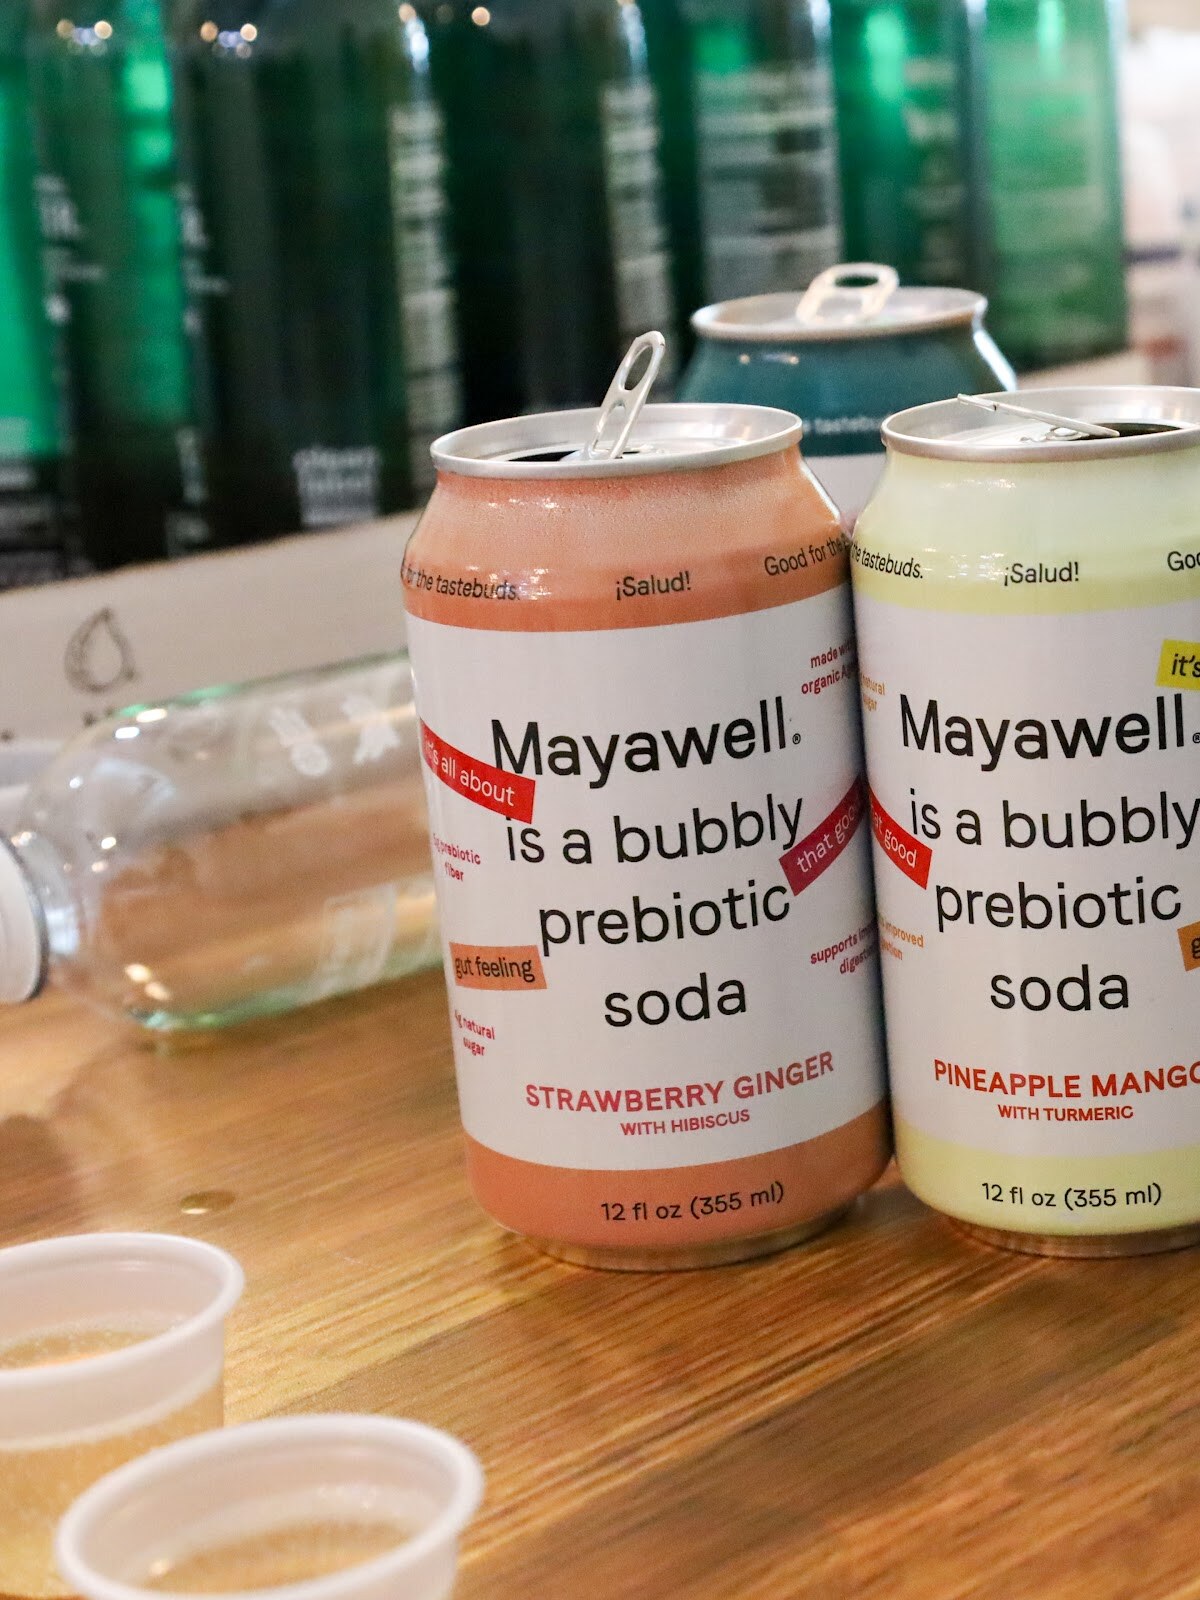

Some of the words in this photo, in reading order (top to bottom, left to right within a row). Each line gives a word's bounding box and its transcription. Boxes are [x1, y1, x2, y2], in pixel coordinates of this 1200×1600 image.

[764, 546, 808, 576] Good
[808, 544, 827, 564] for
[861, 547, 923, 579] tastebuds.
[1003, 561, 1079, 586] ¡Salud!
[417, 569, 434, 591] the
[616, 570, 692, 600] ¡Salud!
[810, 646, 838, 668] made
[801, 669, 840, 694] organic
[441, 756, 456, 779] all
[460, 769, 515, 807] about
[505, 815, 545, 864] is
[562, 827, 592, 865] a
[613, 793, 803, 864] bubbly
[909, 787, 941, 840] is
[956, 808, 982, 847] a
[797, 834, 833, 873] that
[884, 828, 917, 869] good
[539, 879, 790, 957] prebiotic
[935, 876, 1182, 932] prebiotic
[810, 932, 858, 964] supports
[455, 957, 474, 979] gut
[475, 955, 535, 983] feeling
[603, 972, 748, 1028] soda
[990, 964, 1130, 1012] soda
[463, 1017, 495, 1040] natural
[525, 1080, 725, 1113] STRAWBERRY
[732, 1051, 834, 1100] GINGER
[934, 1059, 1081, 1098] PINEAPPLE
[620, 1119, 667, 1137] WITH
[670, 1108, 750, 1133] HIBISCUS
[997, 1104, 1040, 1121] WITH
[1044, 1105, 1134, 1122] TURMERIC
[601, 1202, 626, 1222] 12
[631, 1200, 648, 1221] fl
[656, 1202, 682, 1220] oz
[690, 1191, 742, 1221] (355
[750, 1181, 784, 1207] ml)
[981, 1182, 1004, 1203] 12
[1009, 1186, 1023, 1205] fl
[1031, 1191, 1057, 1208] oz
[1064, 1186, 1117, 1211] (355
[1125, 1182, 1162, 1206] ml)
